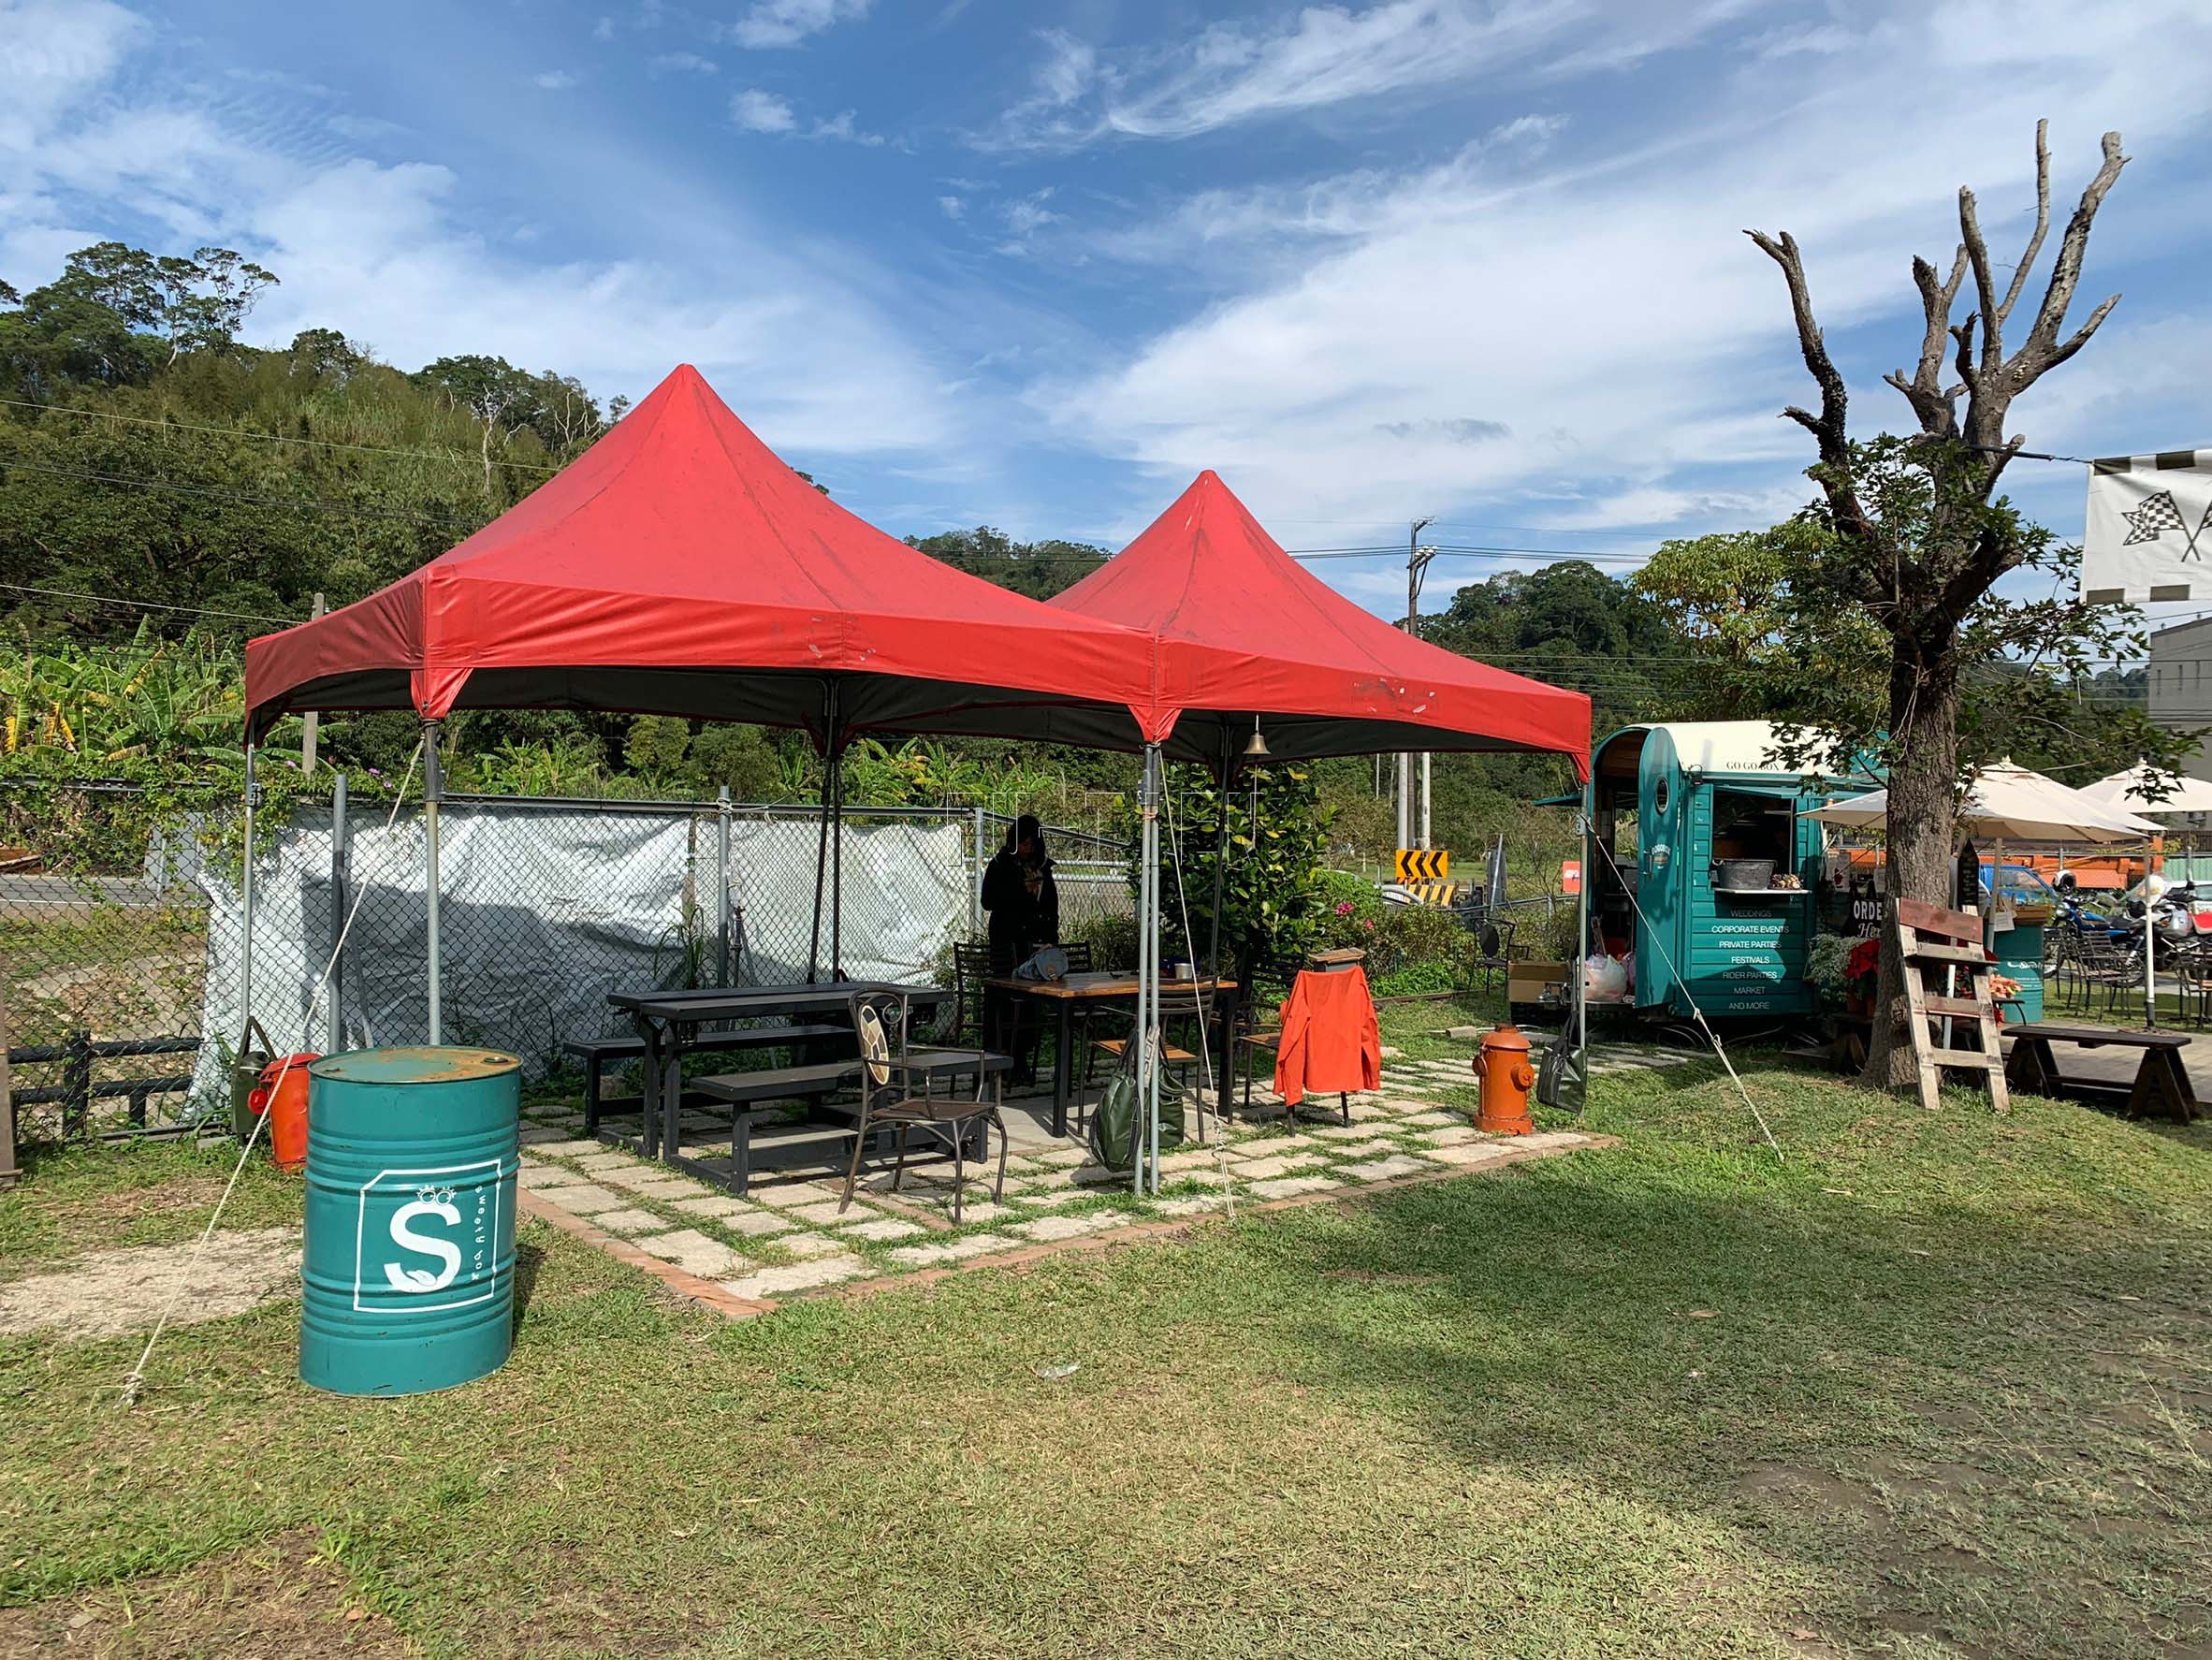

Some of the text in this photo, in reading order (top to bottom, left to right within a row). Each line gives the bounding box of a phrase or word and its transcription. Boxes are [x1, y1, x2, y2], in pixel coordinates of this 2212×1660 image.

[1726, 762, 1740, 770] GO
[1743, 762, 1757, 771] GO
[1853, 899, 1883, 921] ORDE
[1711, 925, 1789, 934] CORPORATE EVENTS
[1719, 940, 1782, 949] PRIVATE PARTIES
[1723, 971, 1777, 980] RIDER PARTIES
[1734, 986, 1766, 995] MARKET
[1728, 1001, 1769, 1010] AND MORE
[384, 1200, 461, 1293] S
[472, 1249, 483, 1280] box
